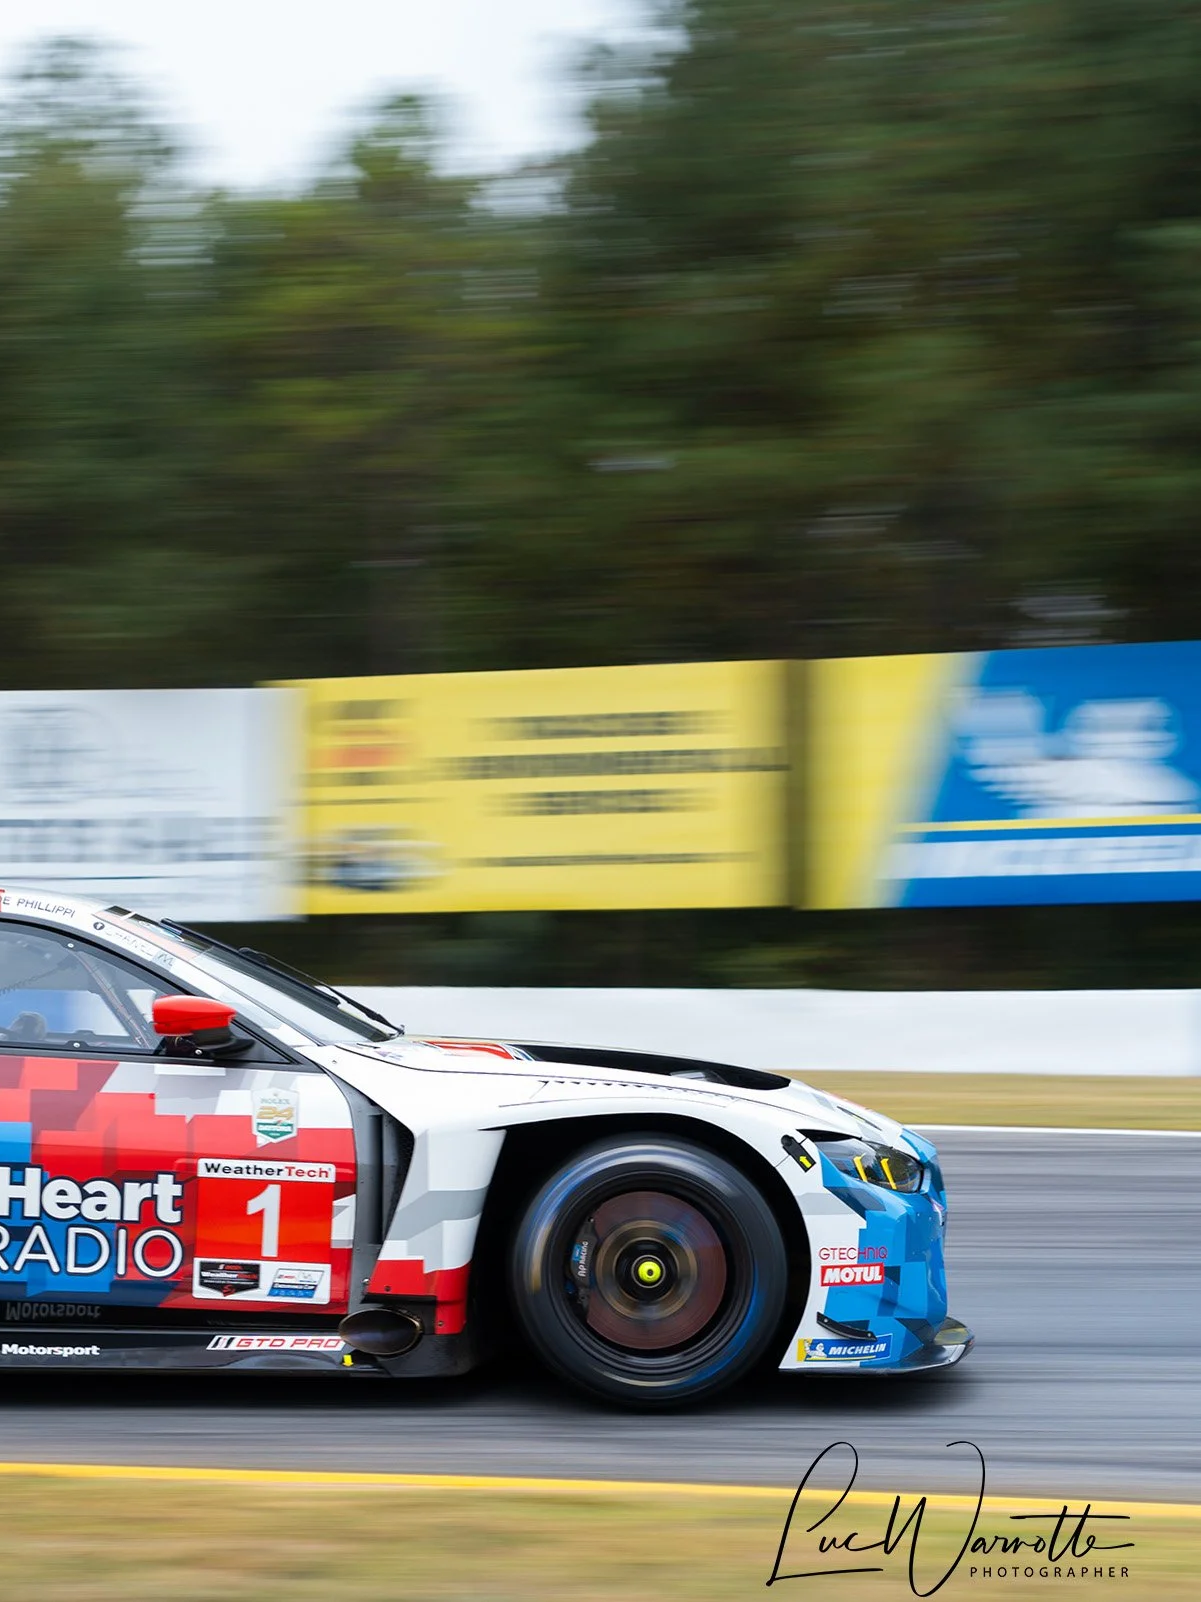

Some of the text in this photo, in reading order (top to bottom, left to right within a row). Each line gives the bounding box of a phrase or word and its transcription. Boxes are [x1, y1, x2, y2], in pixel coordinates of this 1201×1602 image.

[16, 898, 76, 918] PHILLIPPI
[246, 1183, 282, 1258] 1
[818, 1246, 888, 1261] GTECHNIQ
[823, 1266, 883, 1284] MOTUL
[1, 1343, 101, 1358] Motorsport
[236, 1338, 342, 1349] GTD PRO
[829, 1342, 887, 1355] MICHELIN
